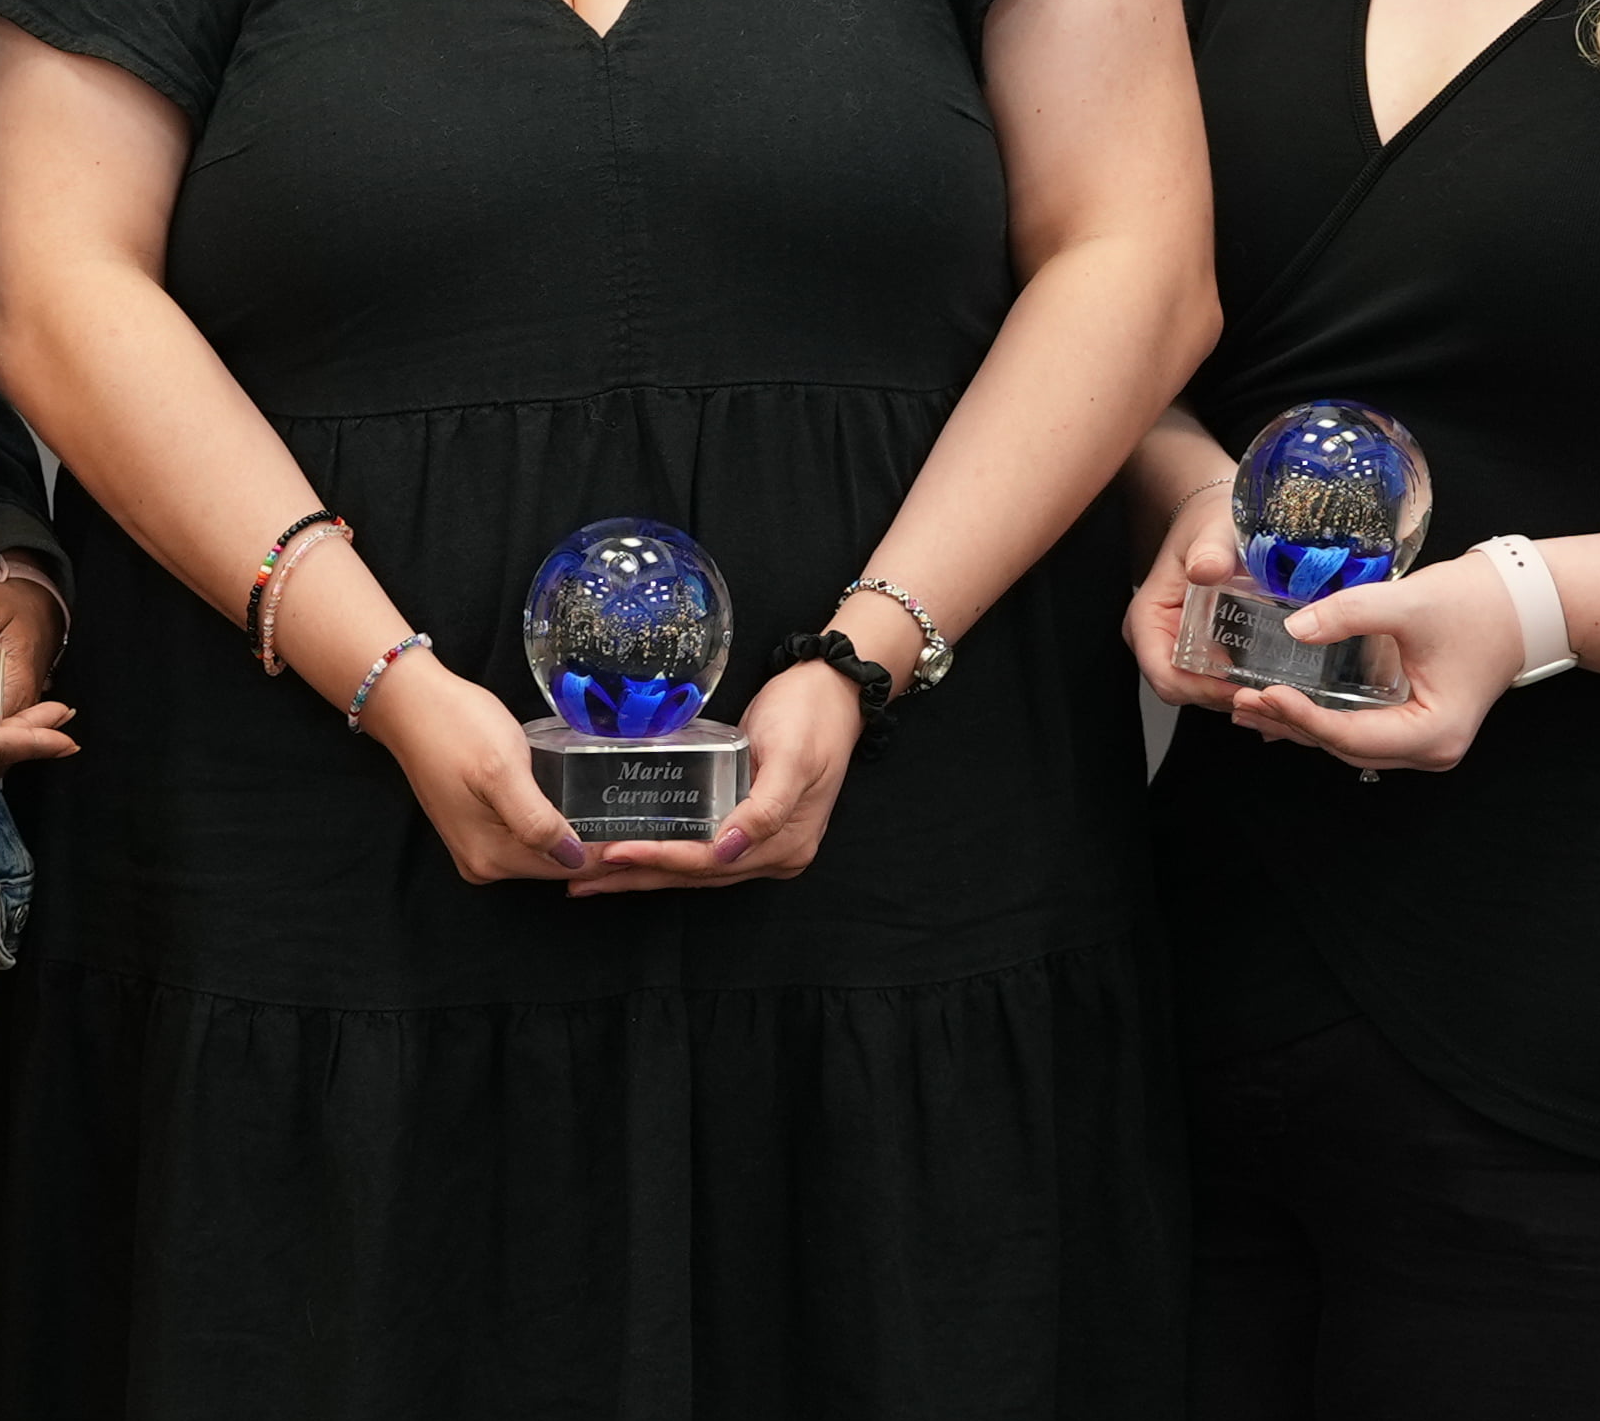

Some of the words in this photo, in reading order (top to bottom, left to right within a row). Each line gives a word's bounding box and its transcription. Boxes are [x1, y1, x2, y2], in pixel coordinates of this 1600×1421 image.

[617, 761, 684, 780] Maria
[601, 785, 700, 804] Carmona
[575, 822, 602, 833] 2026
[605, 820, 644, 833] COLA
[647, 821, 678, 833] Staff
